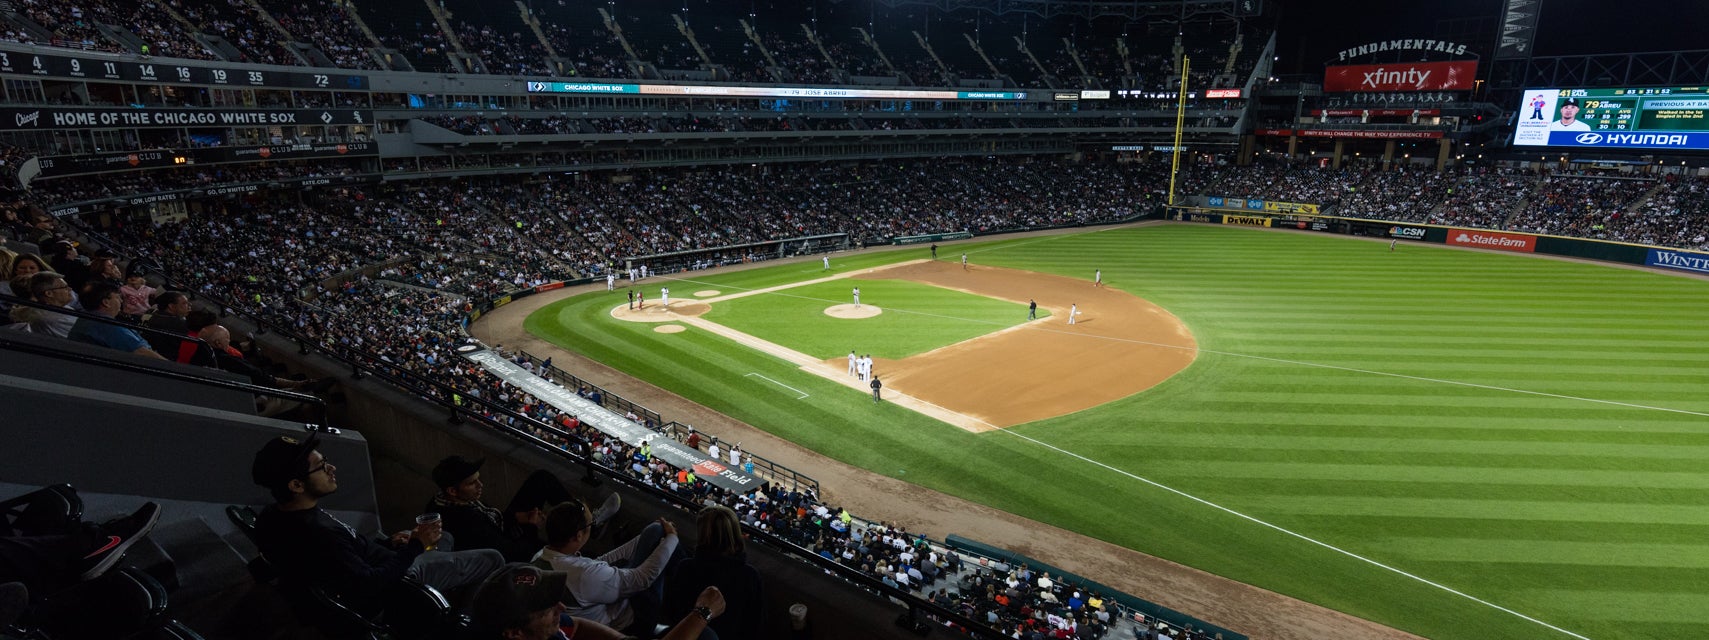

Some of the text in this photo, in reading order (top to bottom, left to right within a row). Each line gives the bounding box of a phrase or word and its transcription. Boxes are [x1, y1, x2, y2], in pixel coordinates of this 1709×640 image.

[1338, 39, 1466, 61] FUNDAMENTALS
[0, 53, 9, 66] 3
[33, 56, 42, 69] 4
[71, 59, 80, 72] 9
[104, 62, 116, 74] 11
[140, 65, 155, 76] 14
[176, 67, 190, 78] 16
[212, 70, 227, 80] 19
[249, 72, 263, 82] 35
[314, 75, 328, 84] 72
[1362, 66, 1431, 88] xfinity
[16, 111, 39, 127] Chicago
[53, 112, 296, 125] HOME OF THE CHICAGO WHITE SOX
[1607, 134, 1688, 145] HYUNDAI
[40, 160, 53, 168] LUB
[1402, 227, 1426, 236] CSN
[585, 406, 630, 428] CHECK-IN
[657, 443, 752, 485] guaranteed Rate Field
